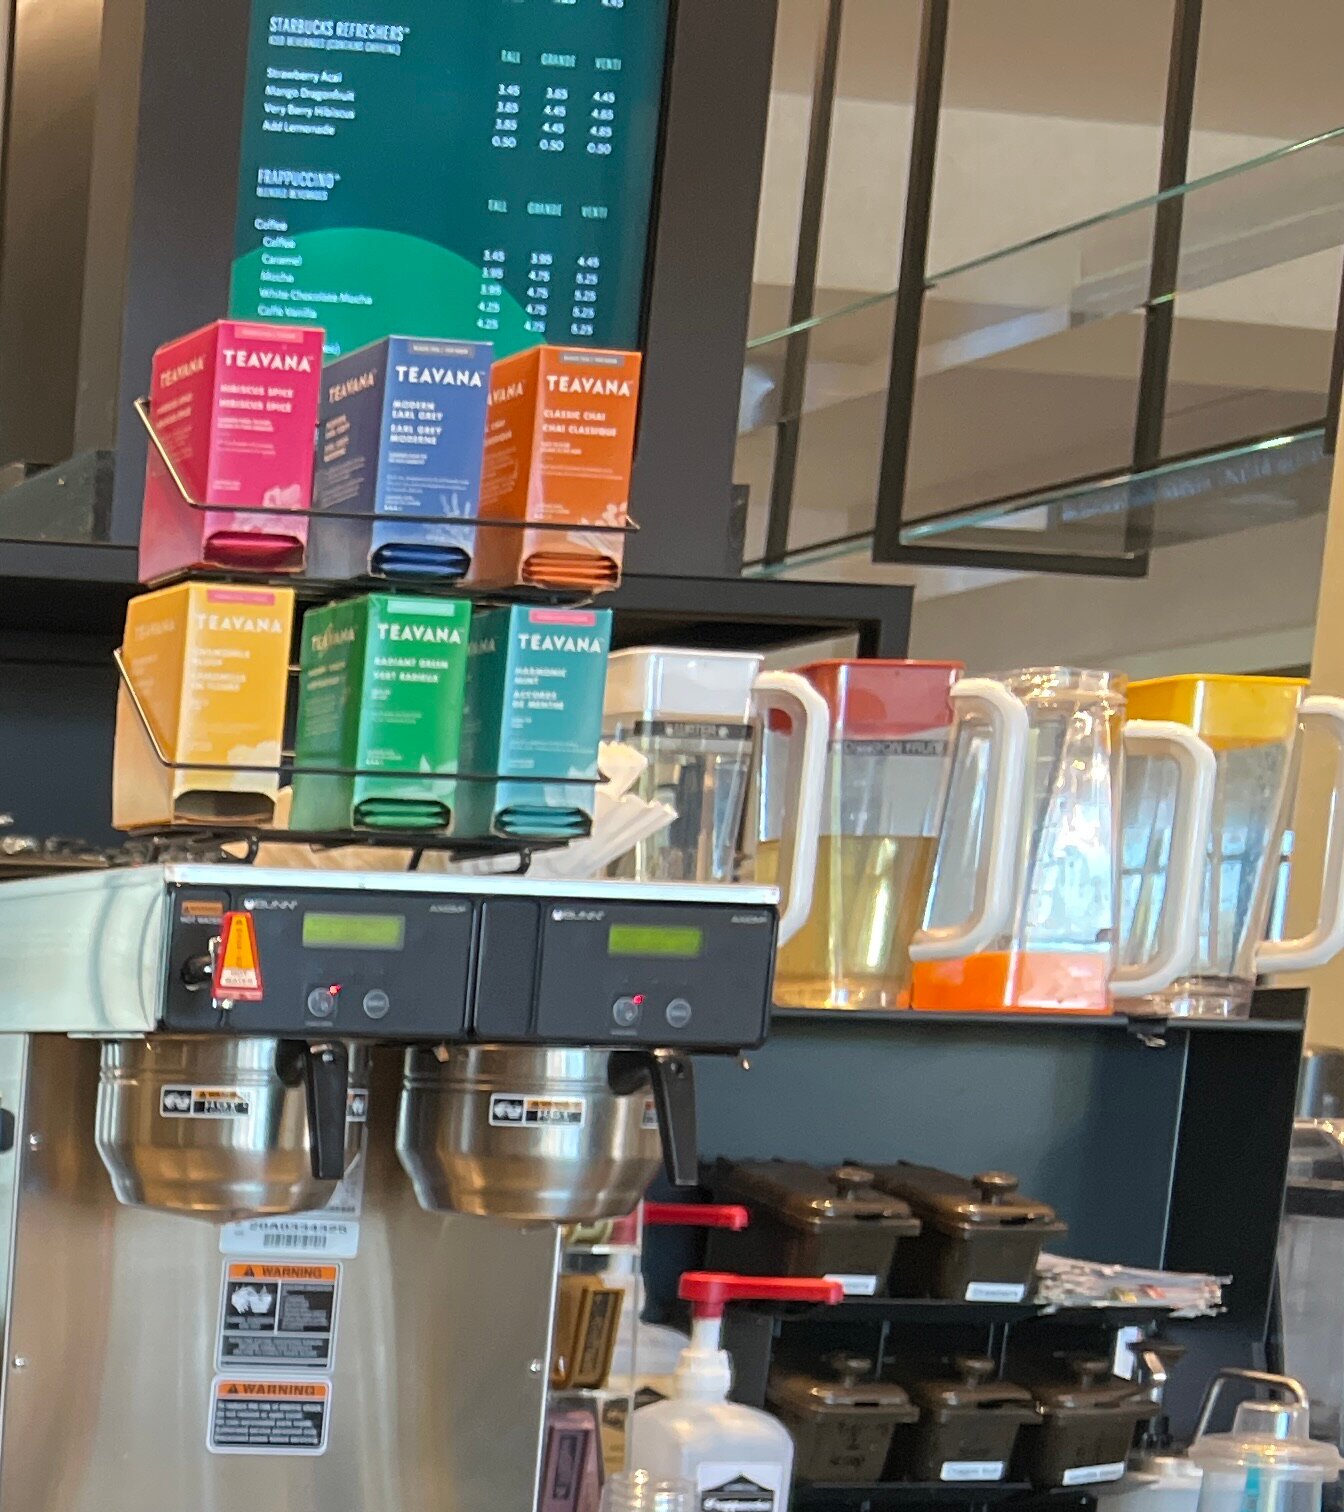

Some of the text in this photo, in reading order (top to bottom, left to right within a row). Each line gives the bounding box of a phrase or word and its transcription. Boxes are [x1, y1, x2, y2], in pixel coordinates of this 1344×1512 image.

[287, 103, 313, 118] Berry
[284, 121, 336, 136] Lemonade
[222, 348, 312, 374] TEAVANA
[395, 365, 482, 388] TEAVANA
[328, 371, 375, 404] TEAVANA
[545, 374, 630, 398] TEAVANA
[392, 399, 435, 411] MODERN
[391, 409, 444, 422] EARL GREY
[543, 409, 606, 422] CLASSIC CHAI
[390, 423, 442, 436] EARL GREY
[541, 423, 617, 438] CHAI CLASSIQUE
[196, 612, 283, 634] TEAVANA
[377, 622, 462, 645] TEAVANA
[517, 632, 602, 654] TEAVANA
[373, 656, 449, 670] RADIANT GREEN
[262, 1265, 322, 1279] WARNING
[242, 1383, 316, 1396] WARNING
